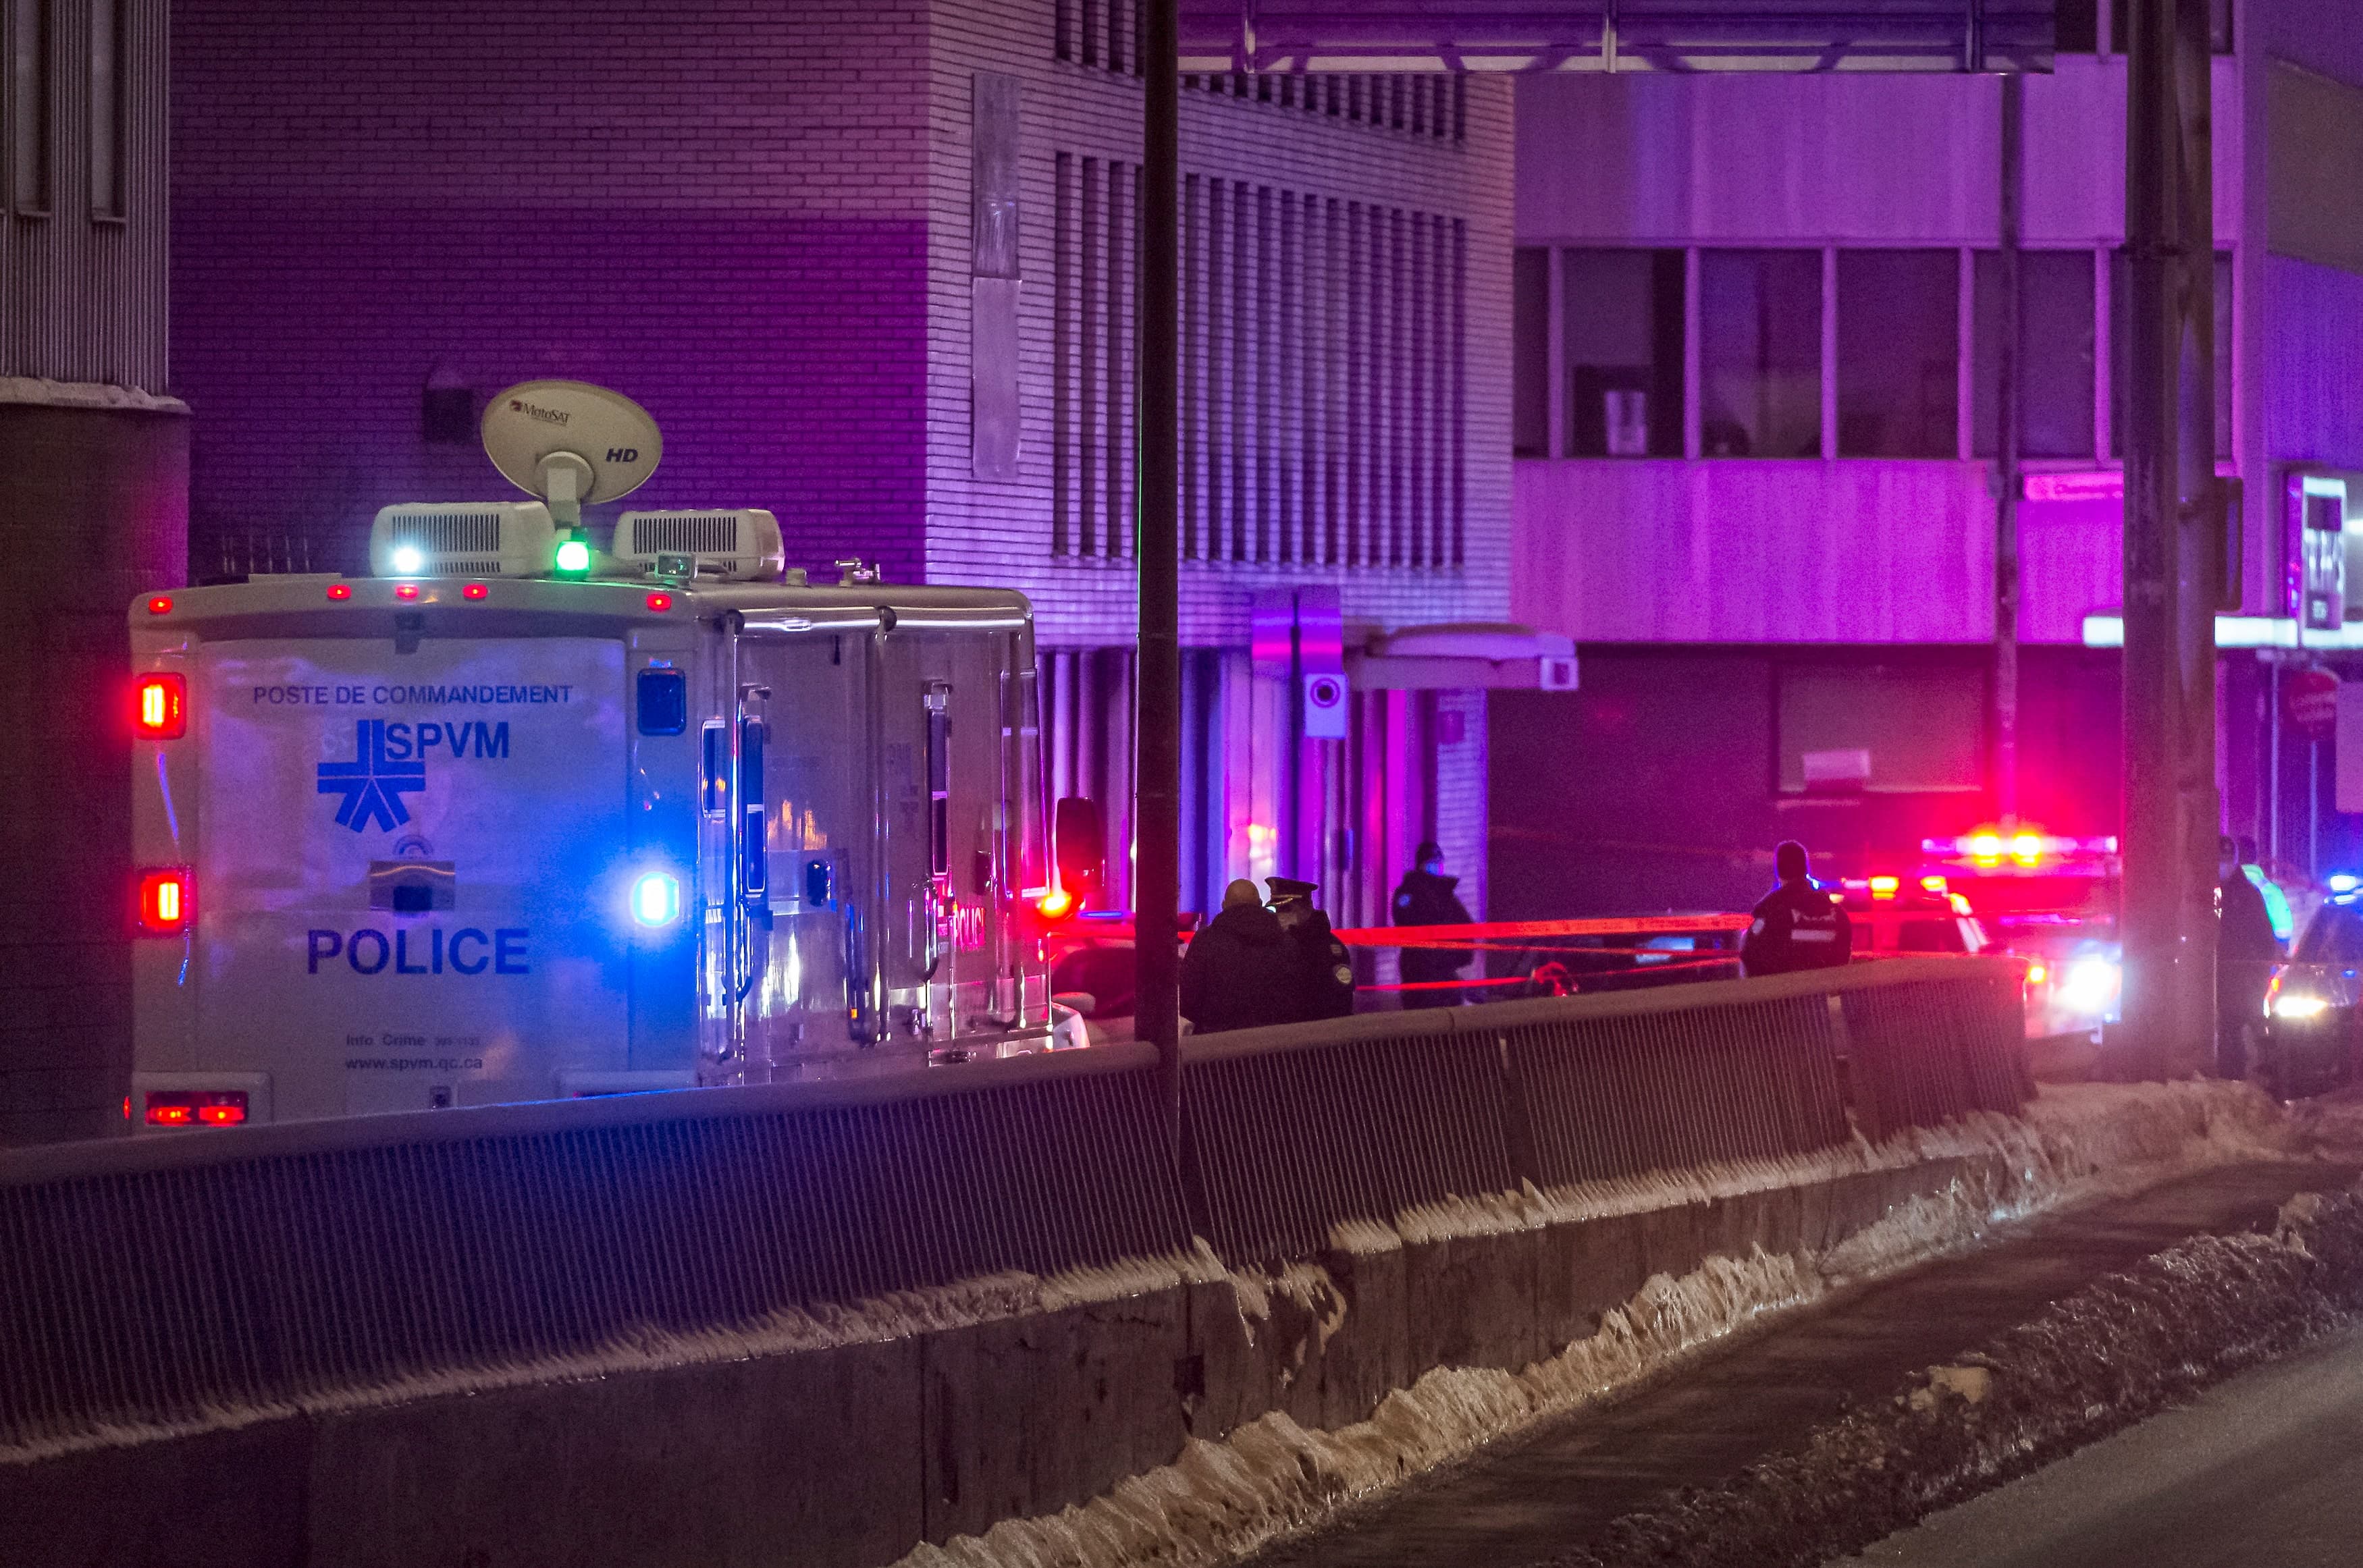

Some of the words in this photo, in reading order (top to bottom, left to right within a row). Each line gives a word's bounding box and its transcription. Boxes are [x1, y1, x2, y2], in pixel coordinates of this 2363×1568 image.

[606, 448, 639, 462] HD
[254, 686, 328, 704] POSTE
[337, 686, 365, 704] DE
[373, 684, 573, 704] COMMANDEMENT
[386, 722, 509, 759] SPVM
[308, 927, 531, 975] POLICE
[346, 1034, 373, 1046] Info
[382, 1033, 425, 1046] Crime
[345, 1058, 483, 1071] www.spvm.qc.ca
